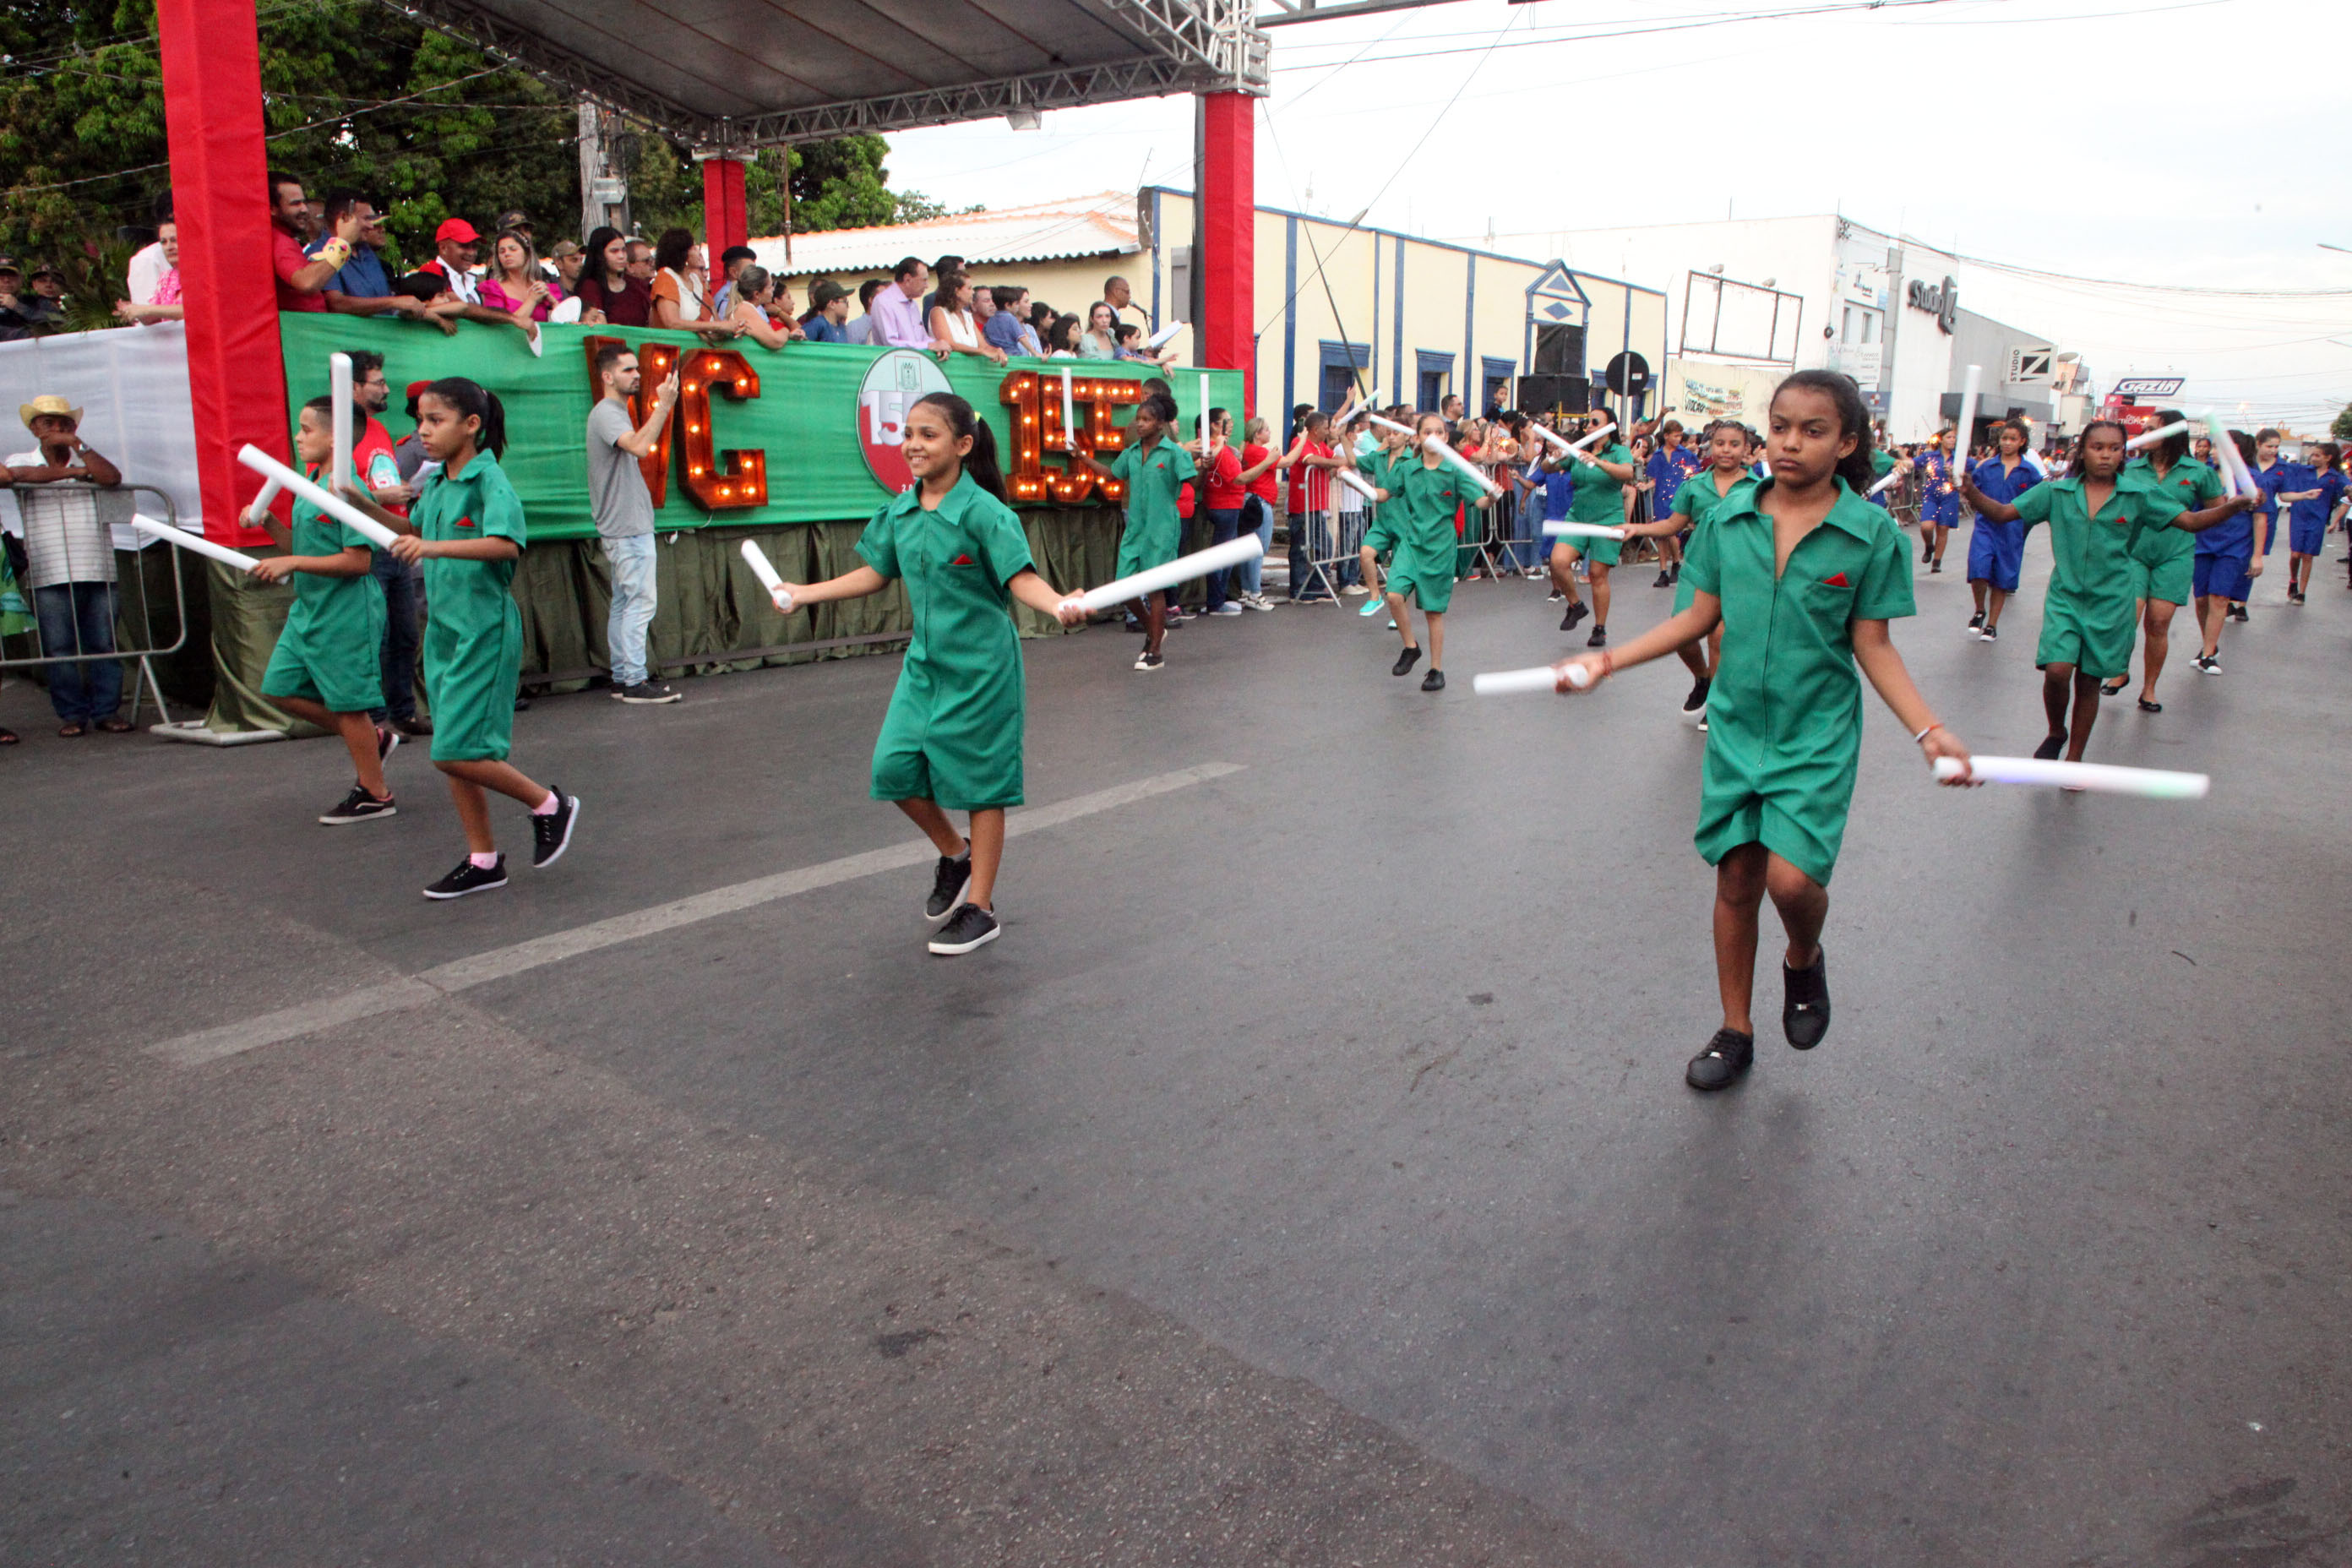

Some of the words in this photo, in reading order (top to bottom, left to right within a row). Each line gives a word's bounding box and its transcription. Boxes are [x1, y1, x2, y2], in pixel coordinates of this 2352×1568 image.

[2010, 349, 2021, 383] STUDIO
[2020, 347, 2052, 383] Z
[2119, 379, 2183, 394] GAZIN
[860, 390, 926, 446] 15
